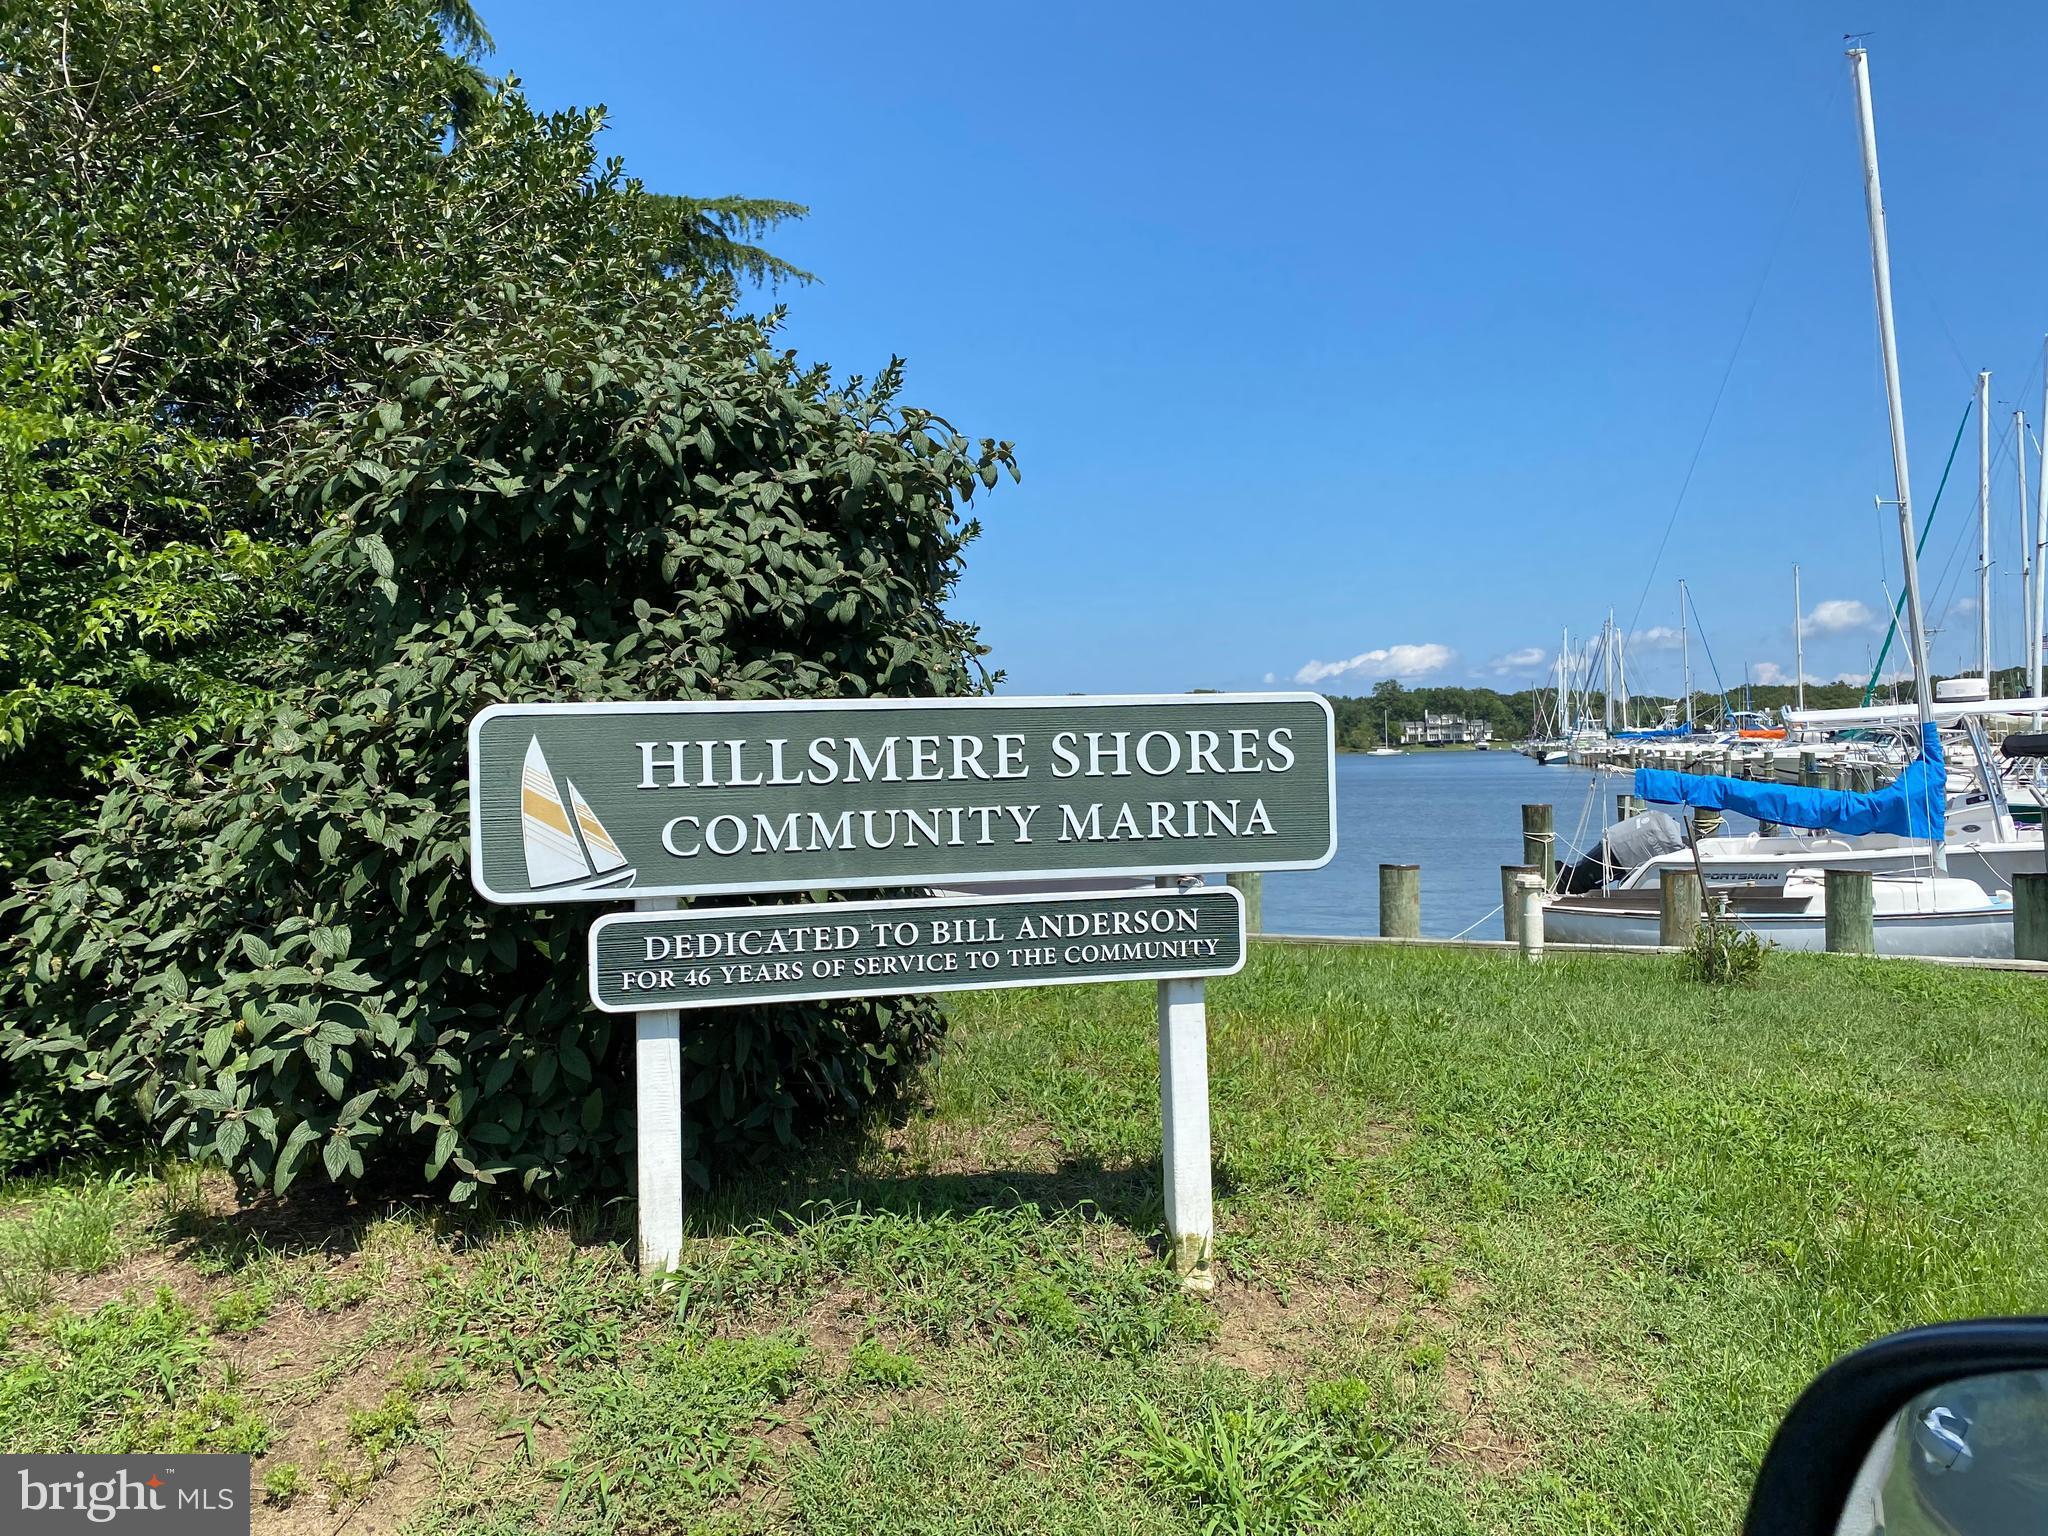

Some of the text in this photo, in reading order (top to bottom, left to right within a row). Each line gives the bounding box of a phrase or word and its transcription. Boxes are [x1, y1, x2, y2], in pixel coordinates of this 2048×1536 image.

[635, 727, 1295, 789] HILLSMERE SHORES
[661, 798, 1278, 857] COMMUNITY MARINA
[1702, 872, 1779, 880] PORTSMAN
[643, 908, 1200, 961] DEDICATED TO BILL ANDERSON
[621, 939, 1220, 991] FOR 46 YEARS OF SERVICE TO THE COMMUNITY
